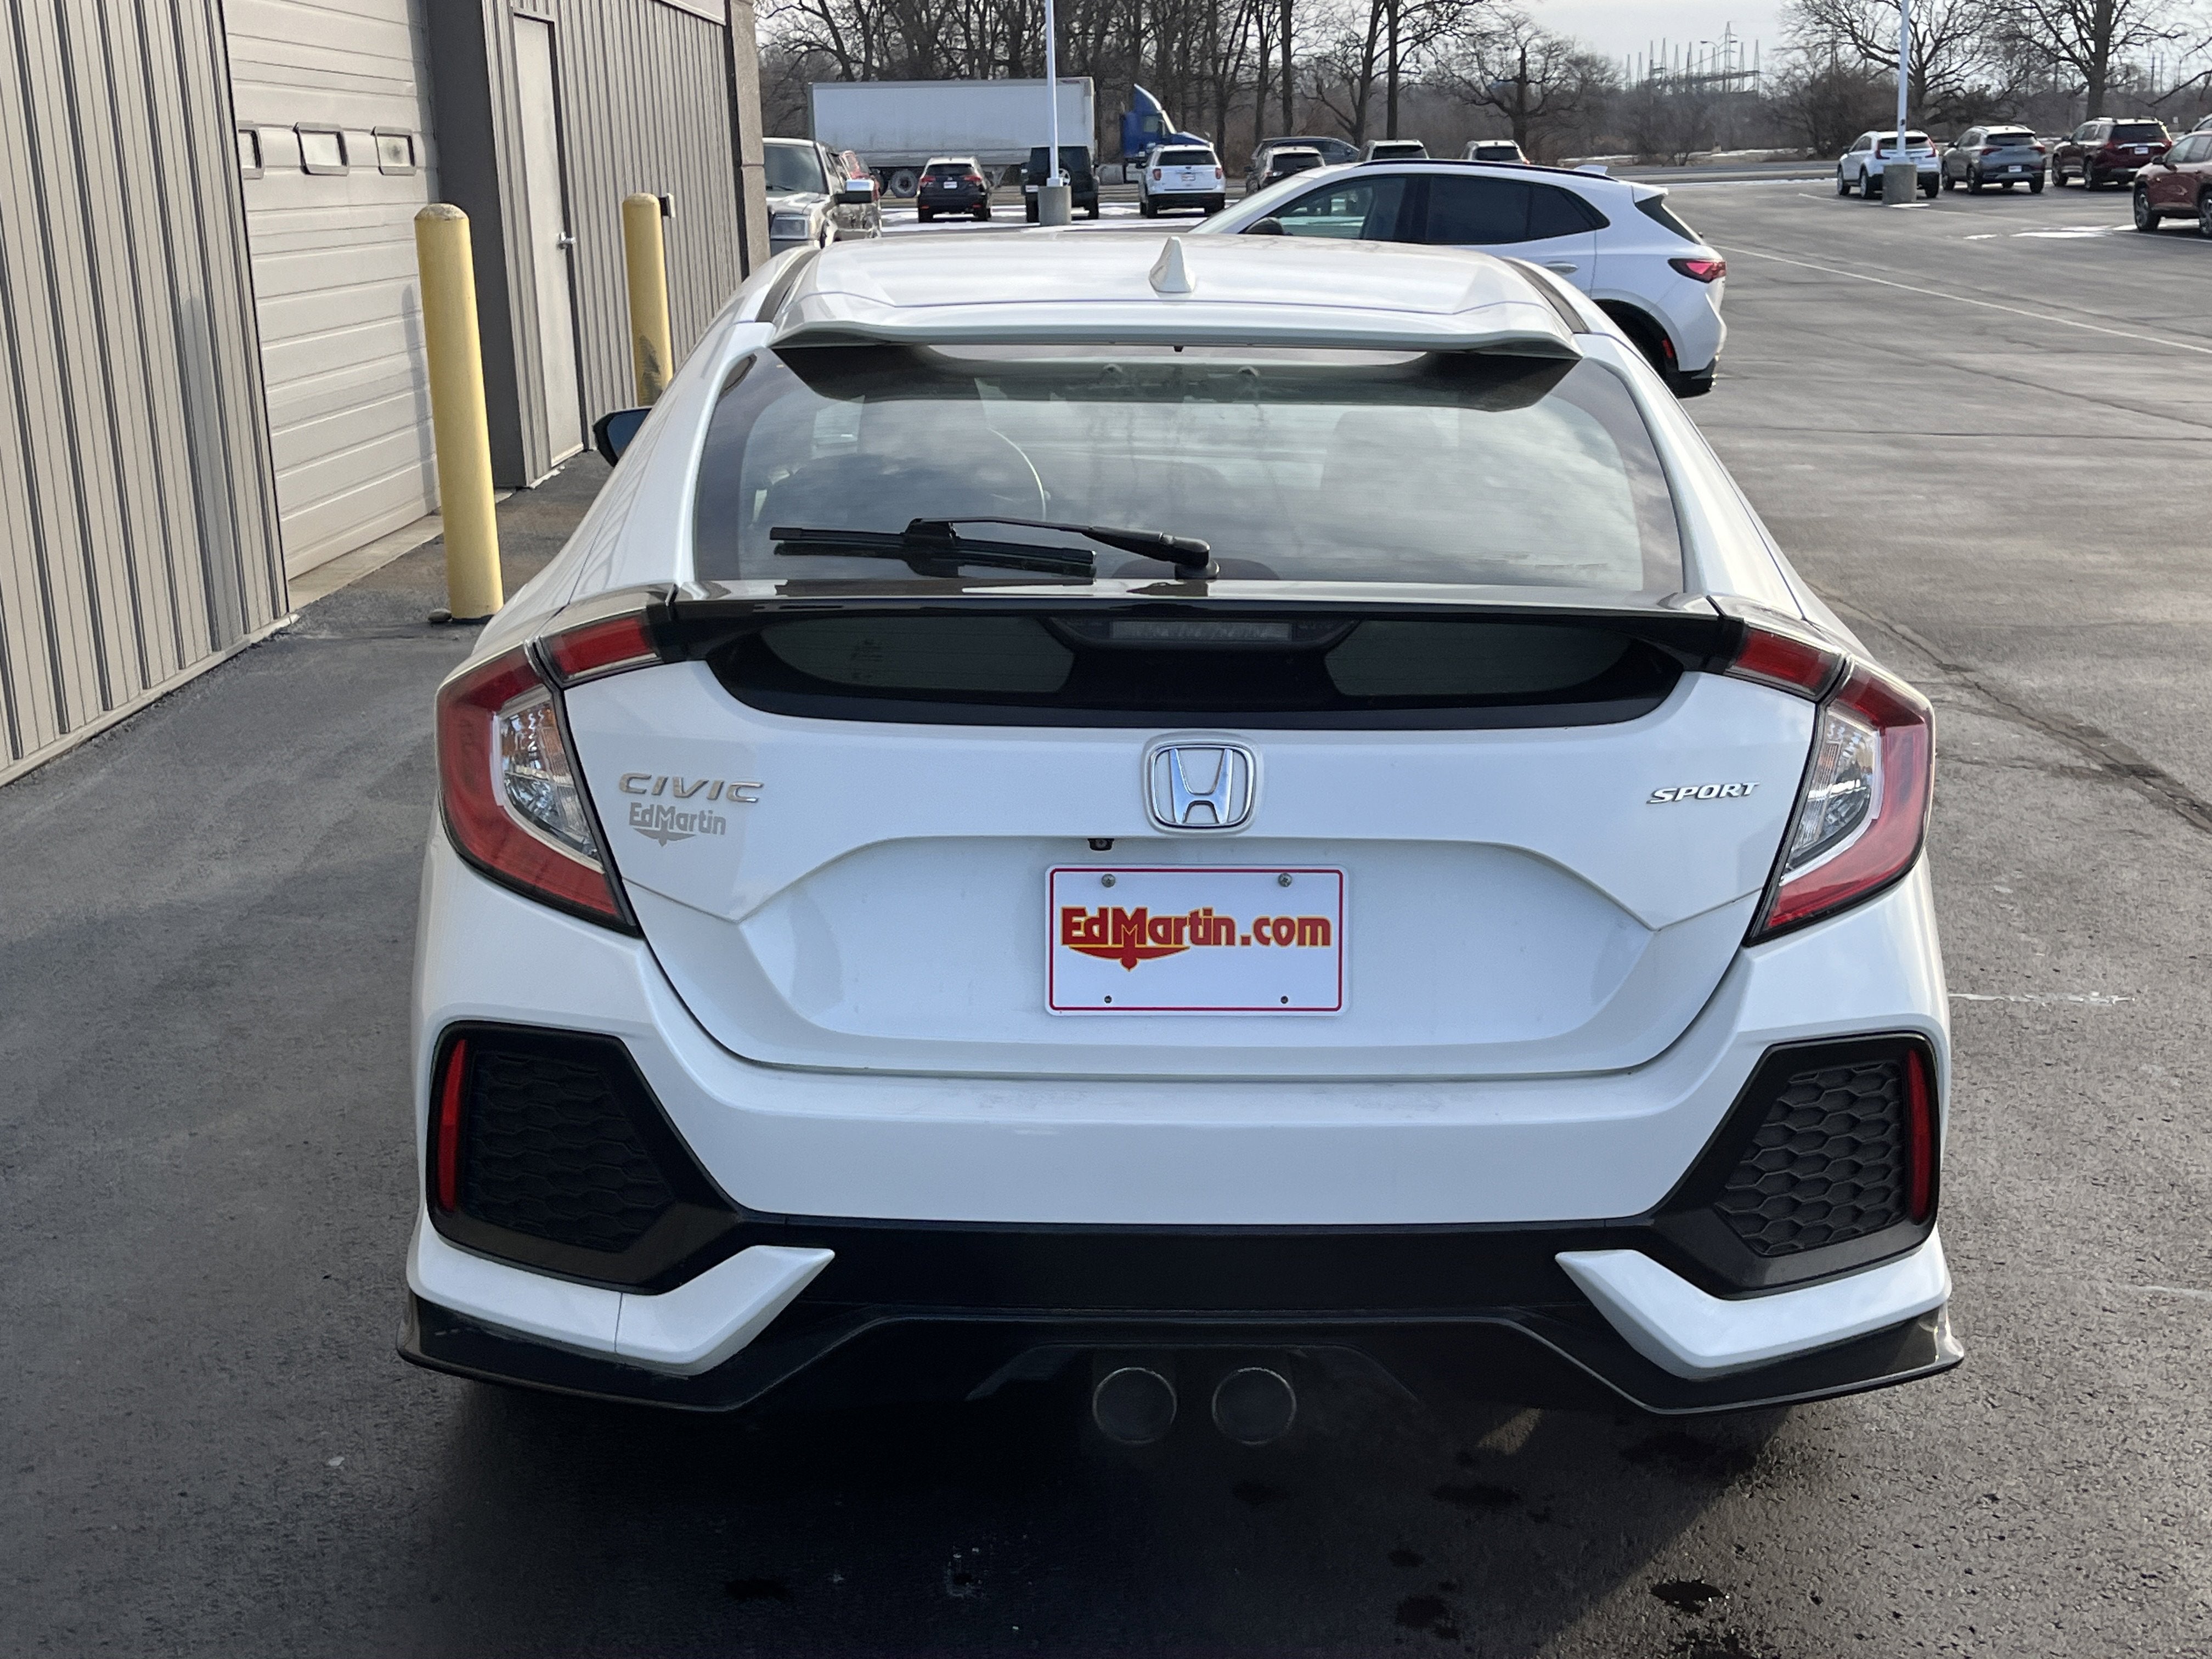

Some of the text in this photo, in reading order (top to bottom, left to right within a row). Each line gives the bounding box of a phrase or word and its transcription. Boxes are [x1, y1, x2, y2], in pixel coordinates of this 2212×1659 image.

[618, 772, 764, 803] CIVIC
[1646, 781, 1760, 804] SPORT
[629, 801, 726, 836] EdMartin
[1060, 906, 1331, 948] EdMartin.com
